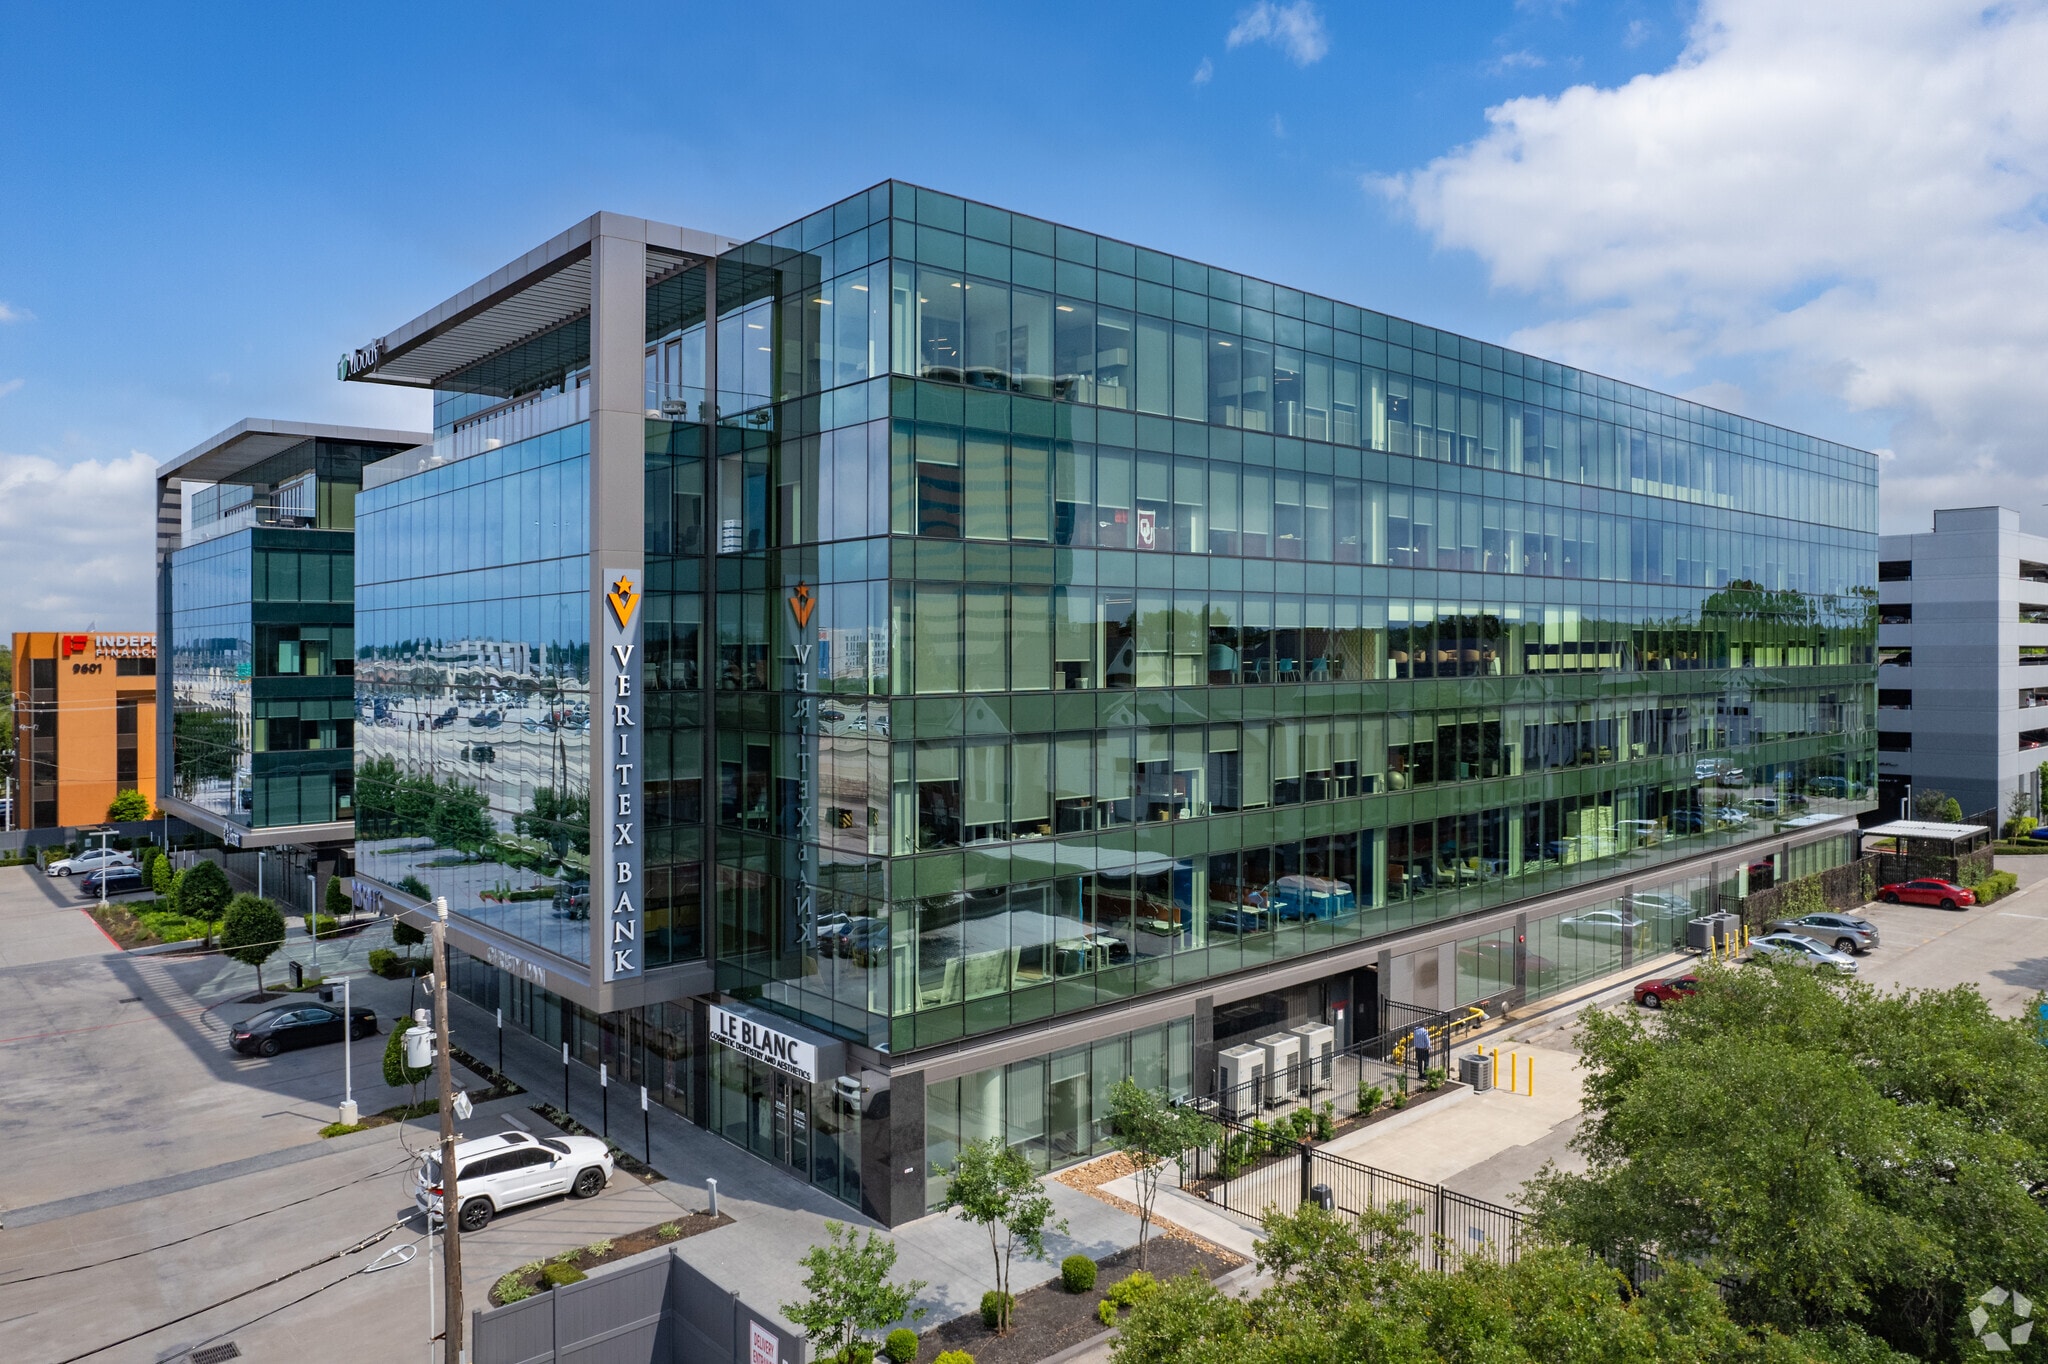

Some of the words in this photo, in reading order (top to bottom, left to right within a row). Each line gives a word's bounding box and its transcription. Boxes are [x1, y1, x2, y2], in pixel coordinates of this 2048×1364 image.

[72, 663, 102, 675] 9601
[613, 645, 636, 846] VERITEX
[613, 861, 636, 973] BANK
[710, 1031, 736, 1048] COSMETIC
[736, 1041, 763, 1060] DENTISTRY
[764, 1054, 777, 1066] AND
[777, 1060, 811, 1081] AESTHETICS
[720, 1012, 737, 1040] LE
[742, 1021, 799, 1065] BLANC
[753, 1332, 774, 1357] DELIVERY
